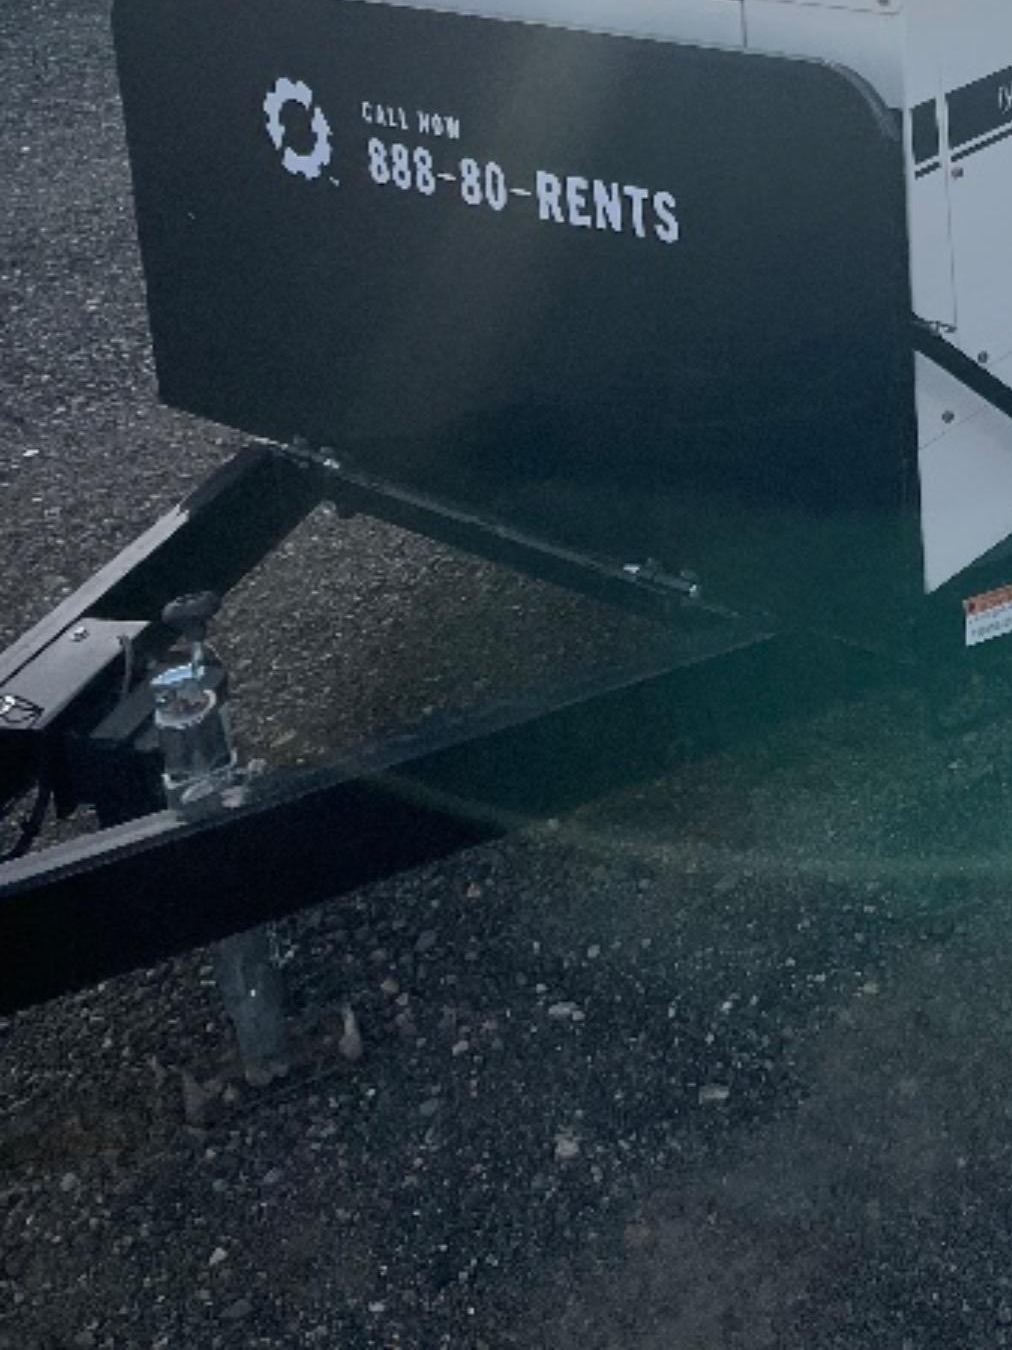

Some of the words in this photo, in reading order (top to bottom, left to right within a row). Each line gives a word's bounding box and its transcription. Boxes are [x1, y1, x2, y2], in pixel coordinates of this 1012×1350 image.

[361, 100, 409, 131] CALL
[418, 109, 460, 140] NOW
[367, 136, 680, 244] 888-80-RENTS
